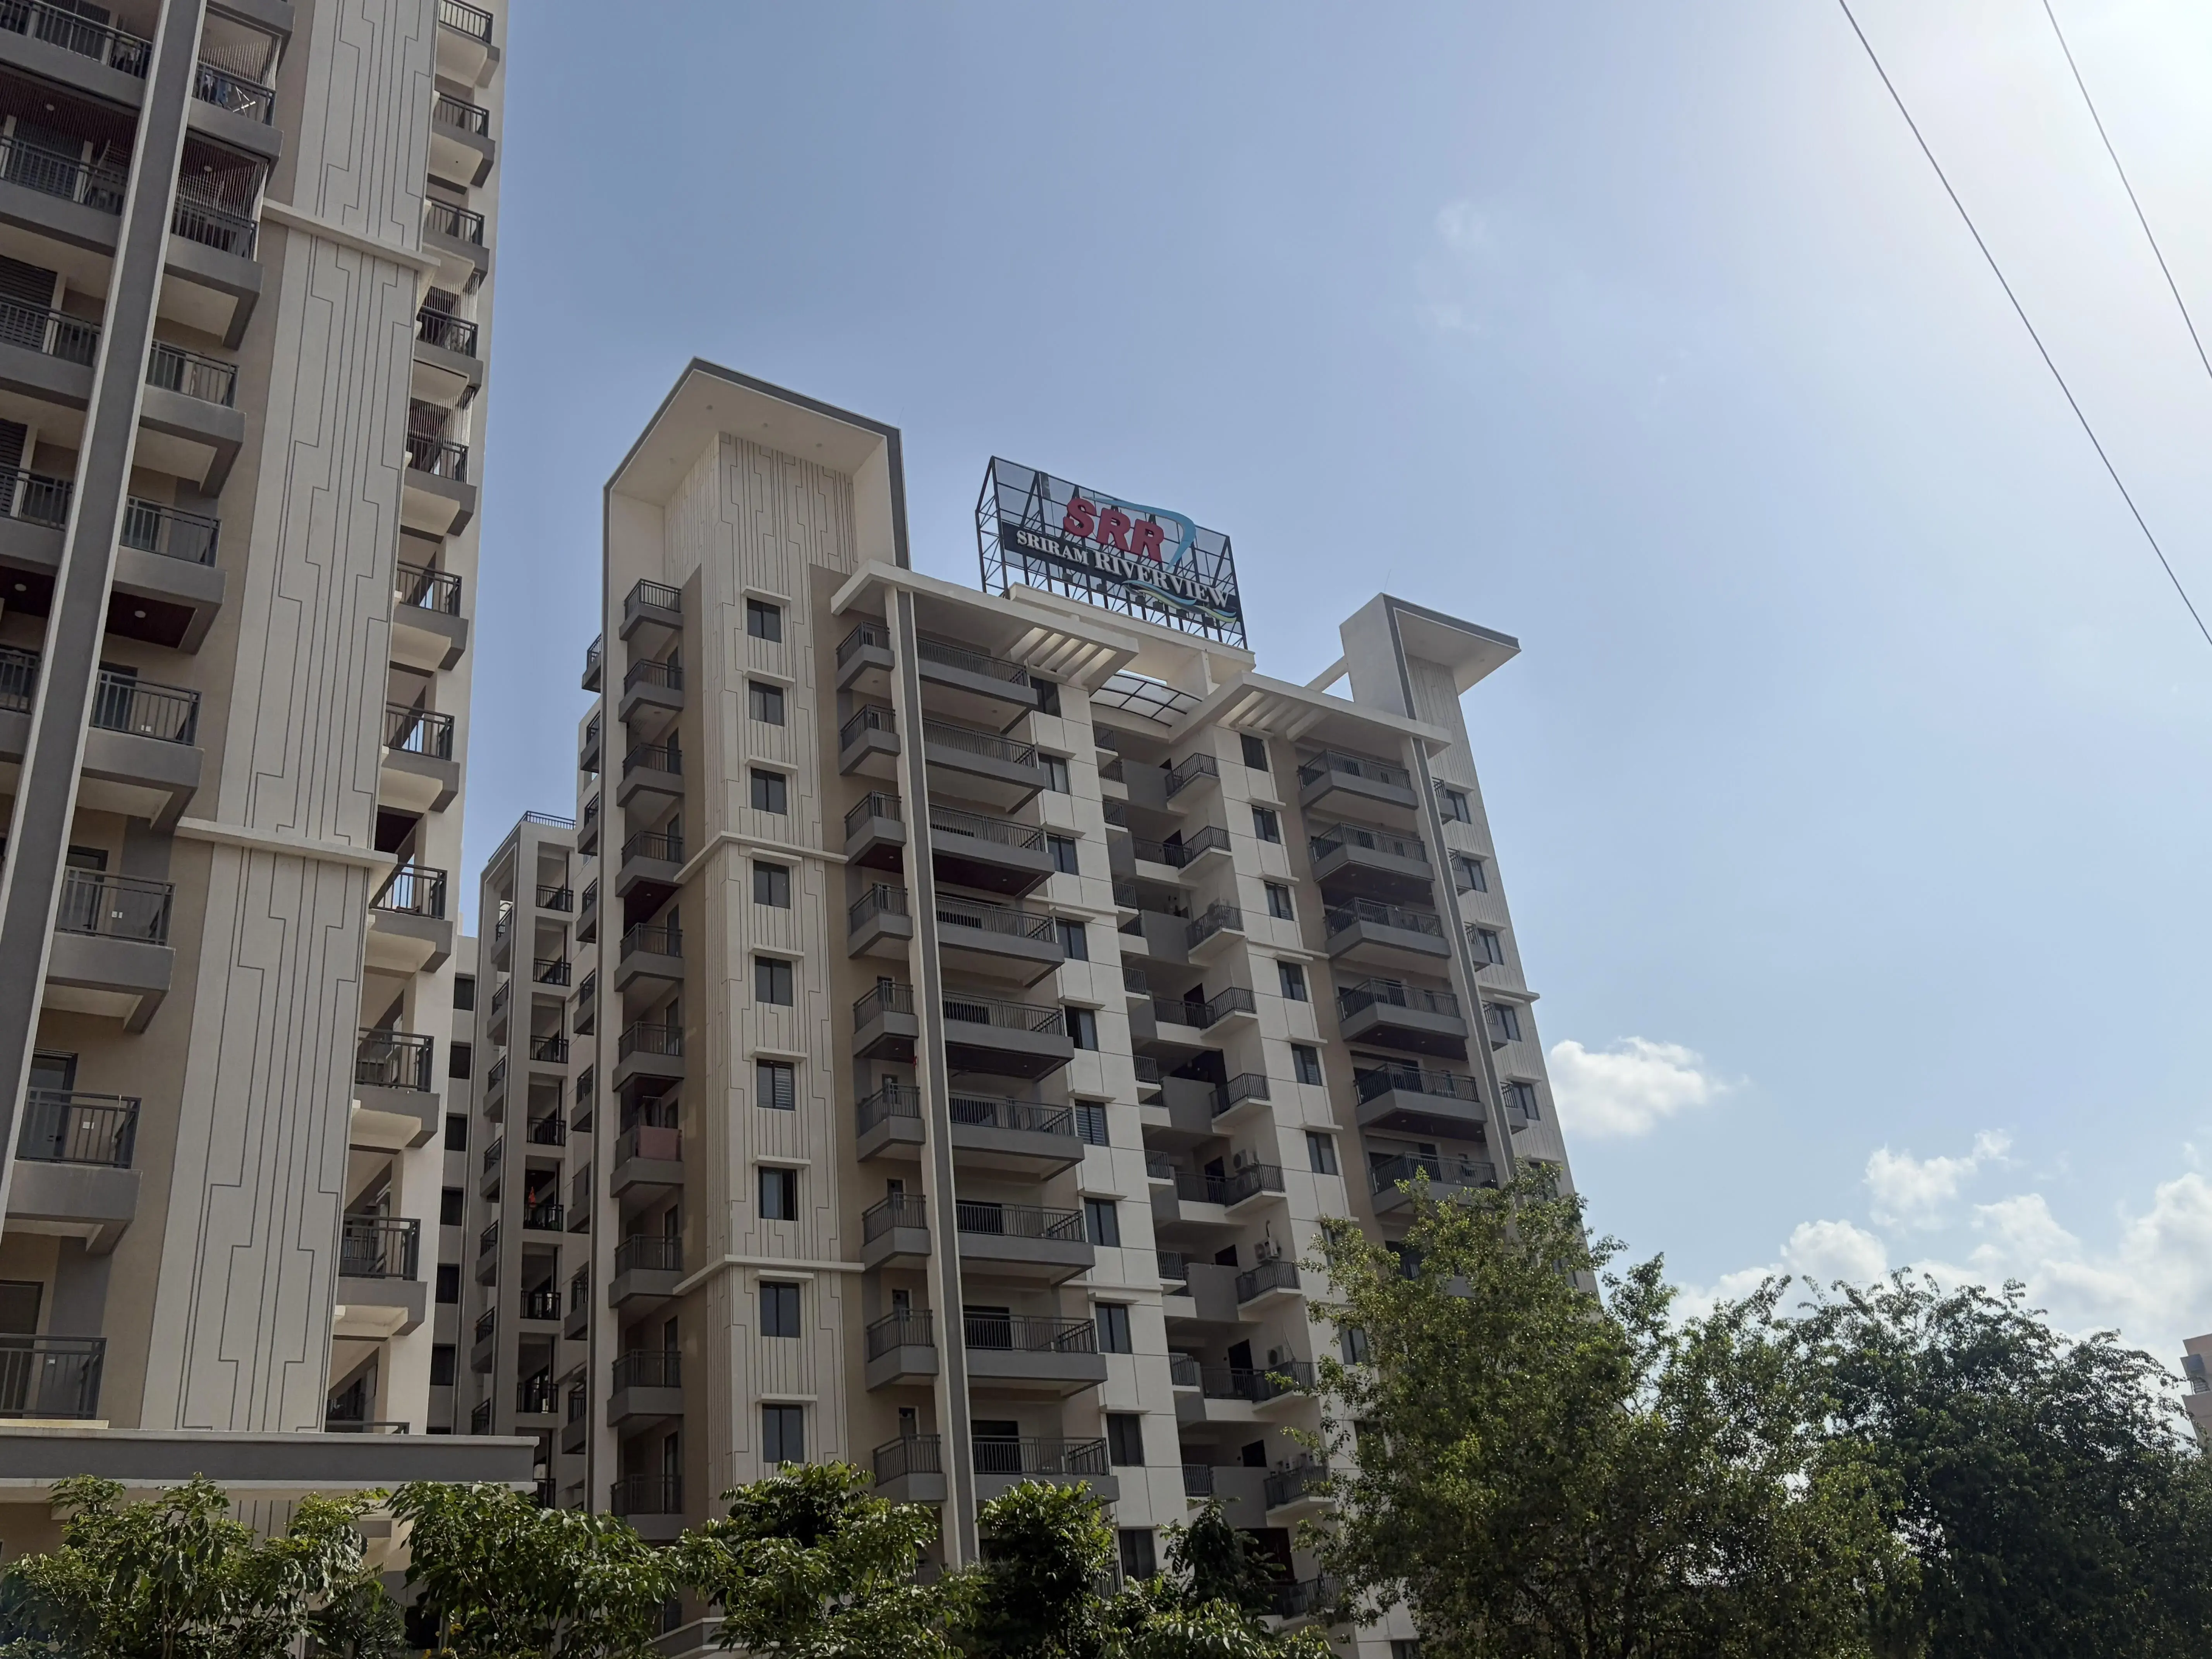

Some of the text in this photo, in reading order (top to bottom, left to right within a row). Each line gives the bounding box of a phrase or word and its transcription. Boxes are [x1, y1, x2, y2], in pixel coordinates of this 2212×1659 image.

[1063, 498, 1164, 562] SRR
[1017, 531, 1230, 608] SRIRAM RIVERVIEW
